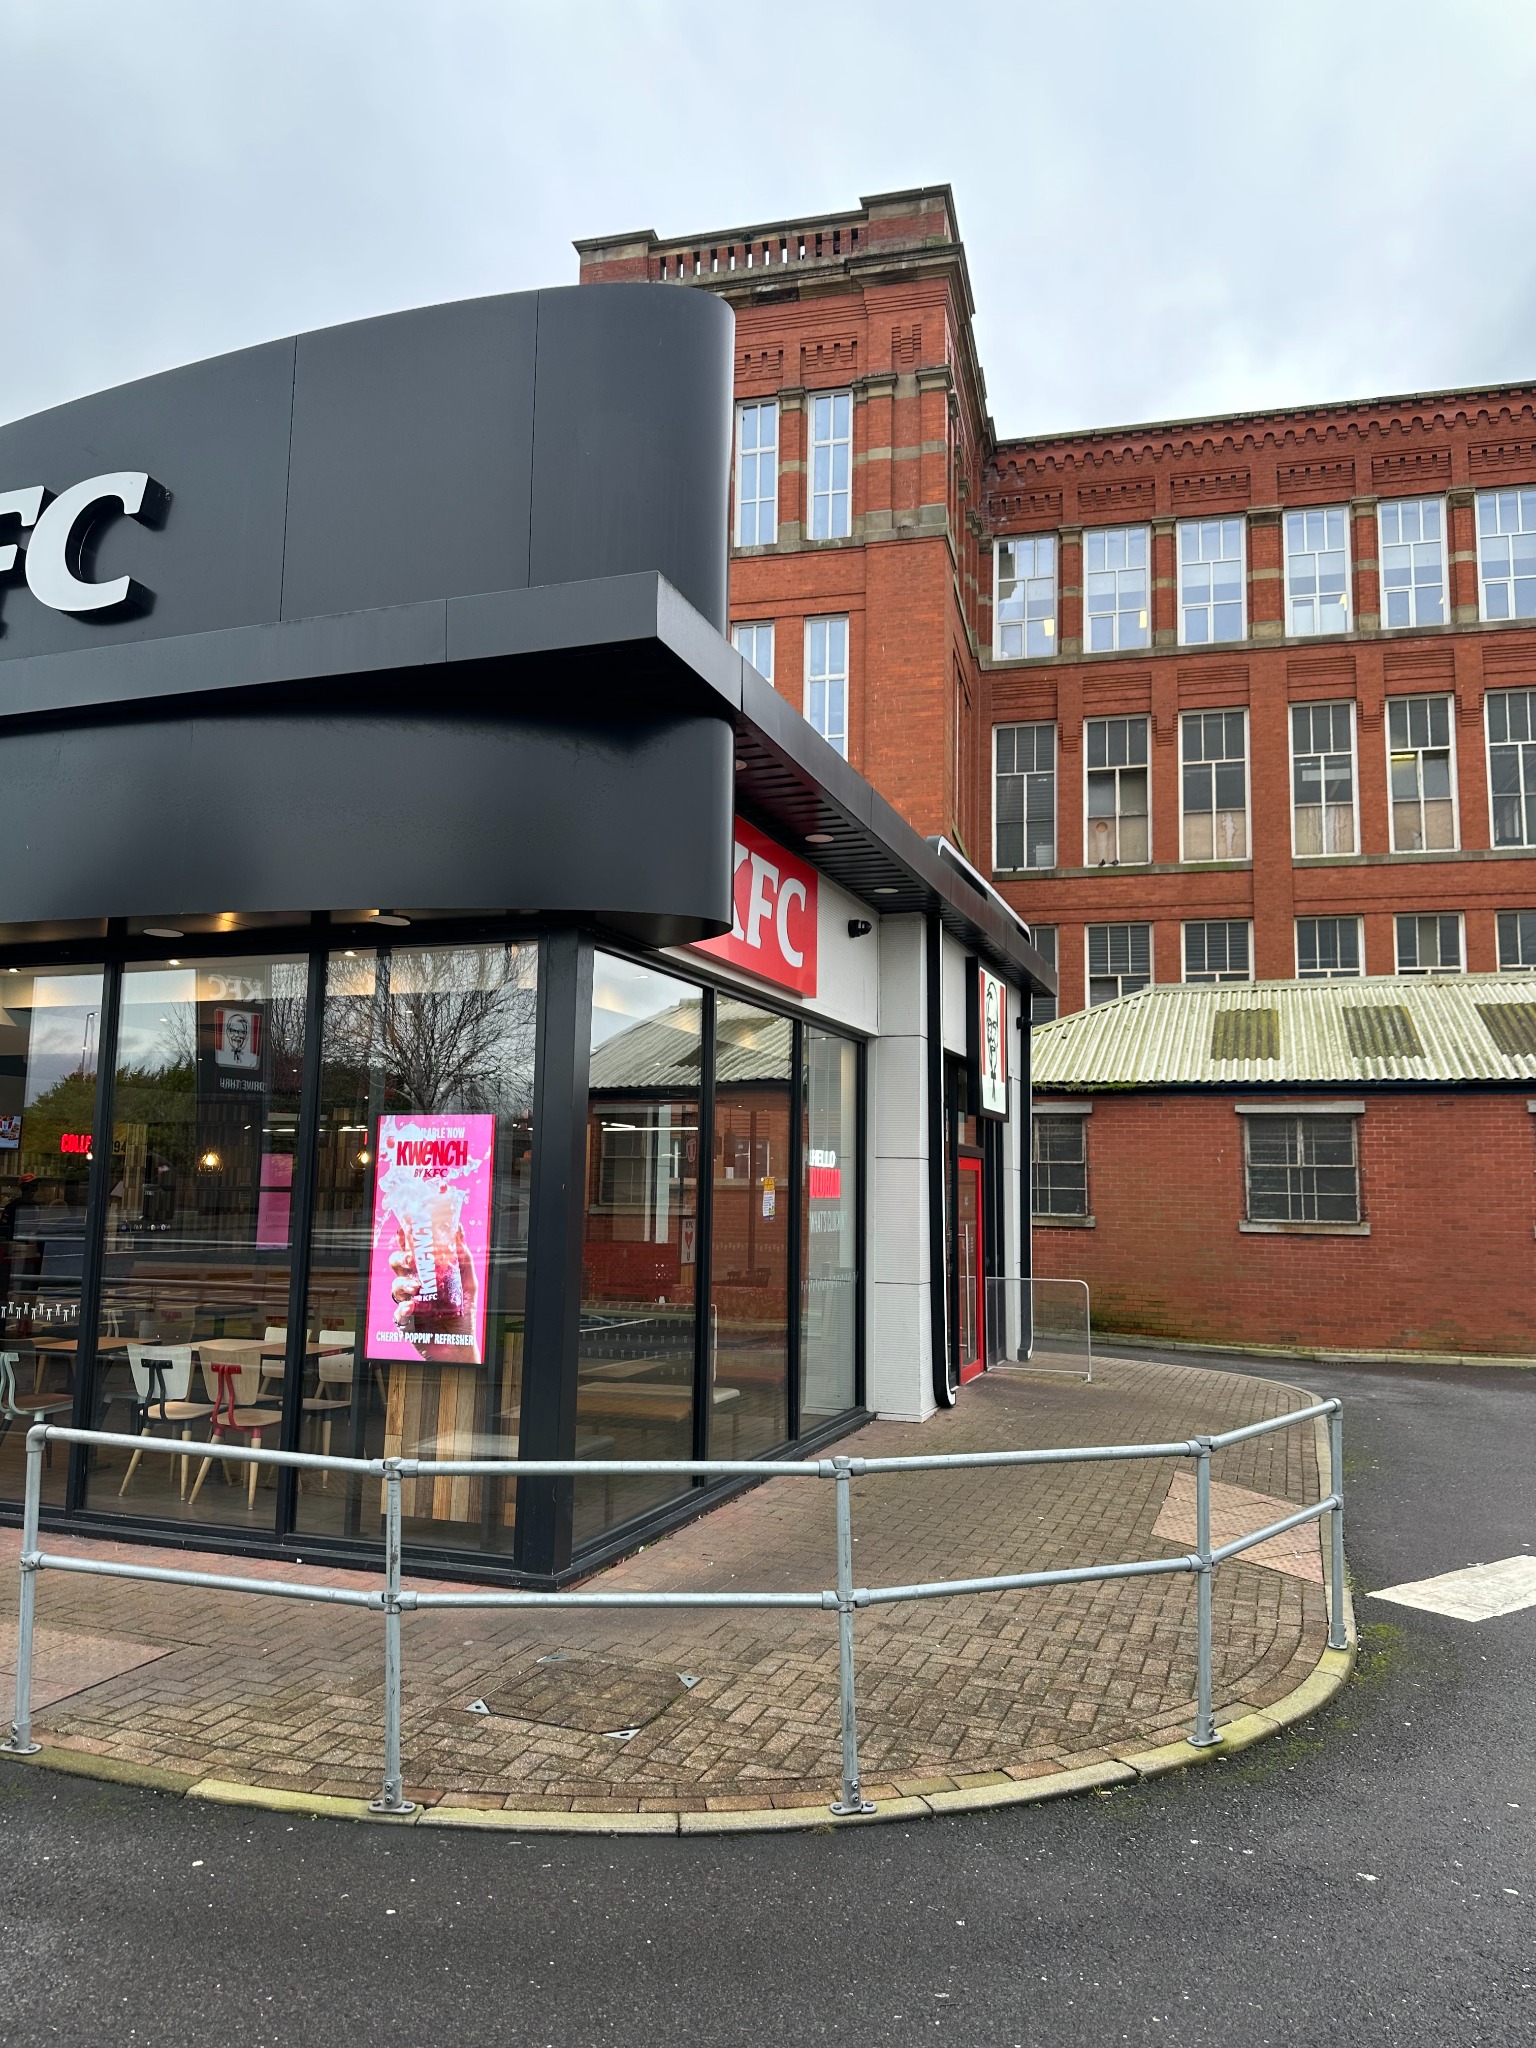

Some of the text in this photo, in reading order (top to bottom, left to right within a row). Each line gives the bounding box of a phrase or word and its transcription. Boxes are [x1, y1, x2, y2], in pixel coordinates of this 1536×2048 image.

[447, 1127, 466, 1139] NOW
[414, 1168, 448, 1178] BY KFC
[423, 1293, 438, 1302] KFC
[376, 1330, 404, 1343] CHERRY
[434, 1334, 474, 1346] REFRESHER
